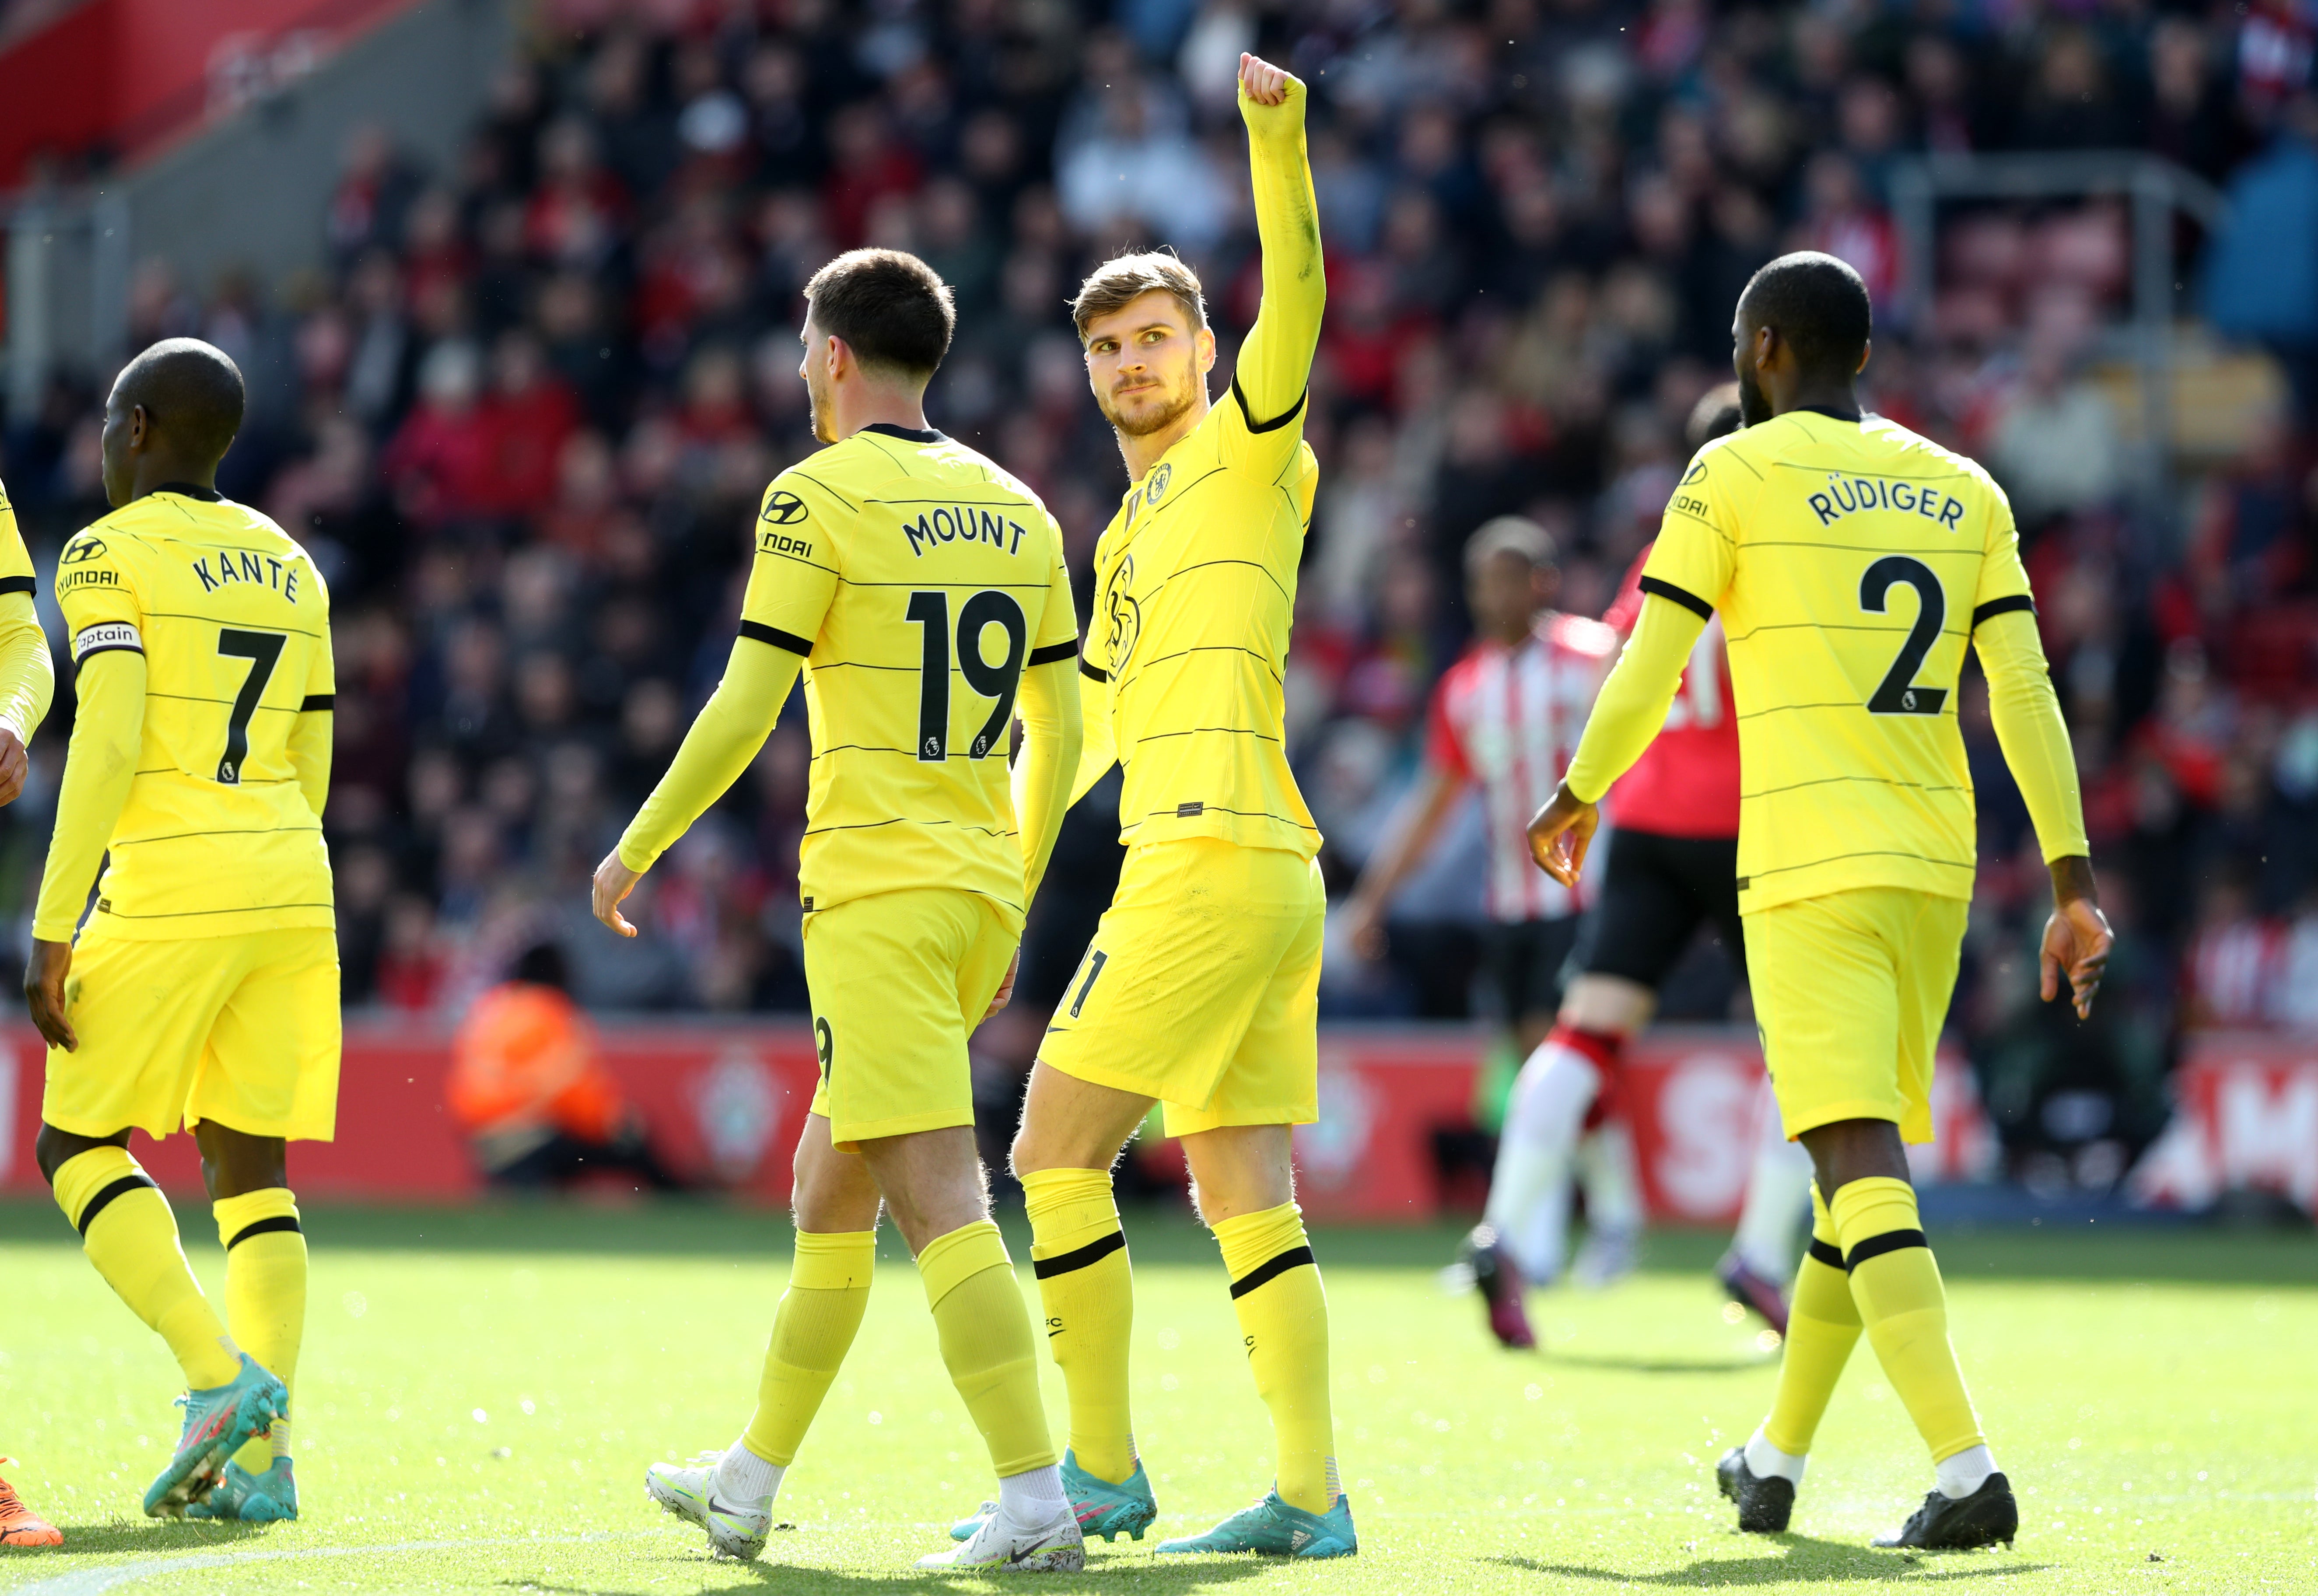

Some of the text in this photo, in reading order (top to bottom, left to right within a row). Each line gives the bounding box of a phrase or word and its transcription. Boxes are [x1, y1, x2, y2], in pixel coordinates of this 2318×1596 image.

[902, 506, 1026, 558] MOUNT
[1807, 471, 1965, 533] RÜDIGER
[193, 551, 299, 606] KANTÉ
[1859, 554, 1950, 716] 2
[217, 627, 289, 786] 7
[904, 589, 1027, 763] 19
[815, 1015, 833, 1091] 9
[1291, 1533, 1311, 1550] adidas
